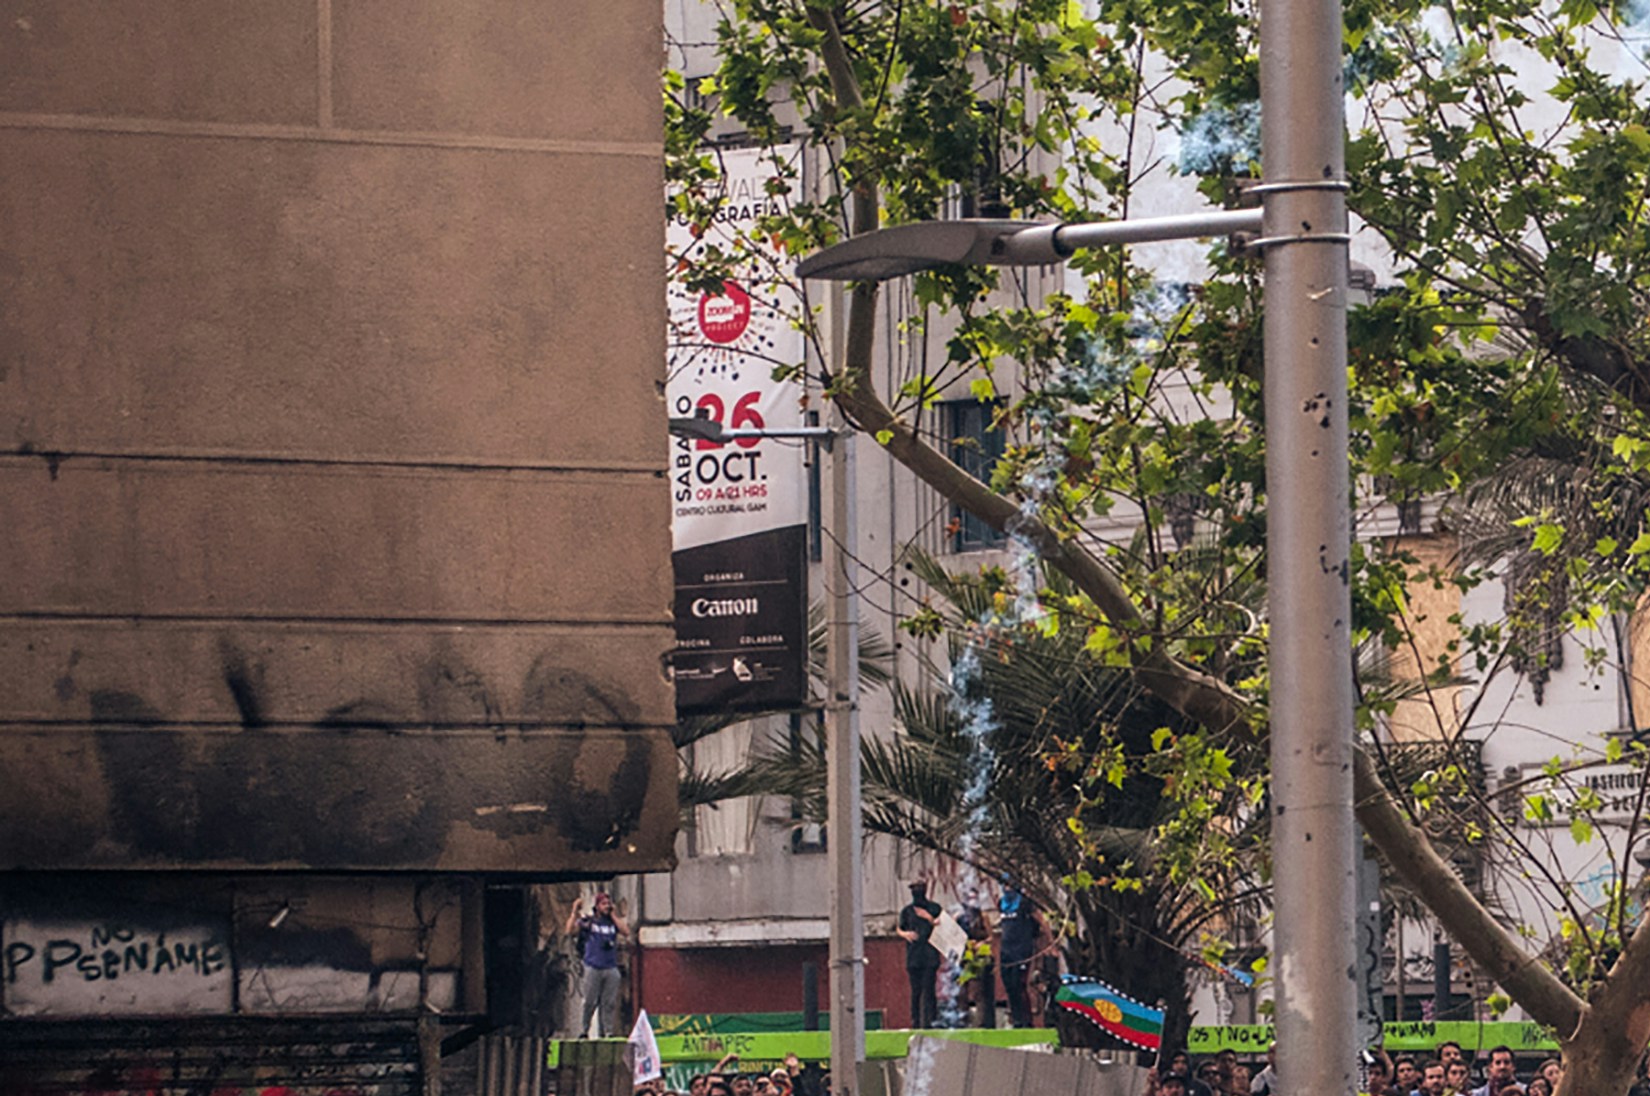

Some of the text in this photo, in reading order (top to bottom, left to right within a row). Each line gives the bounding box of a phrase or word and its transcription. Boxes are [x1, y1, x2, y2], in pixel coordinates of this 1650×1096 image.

[695, 391, 765, 451] 26
[675, 395, 692, 502] SABAO
[696, 451, 767, 484] OCT.
[696, 488, 712, 501] 09
[715, 488, 725, 500] A
[743, 484, 768, 498] HRS
[691, 598, 758, 617] Canon
[92, 926, 135, 948] NO
